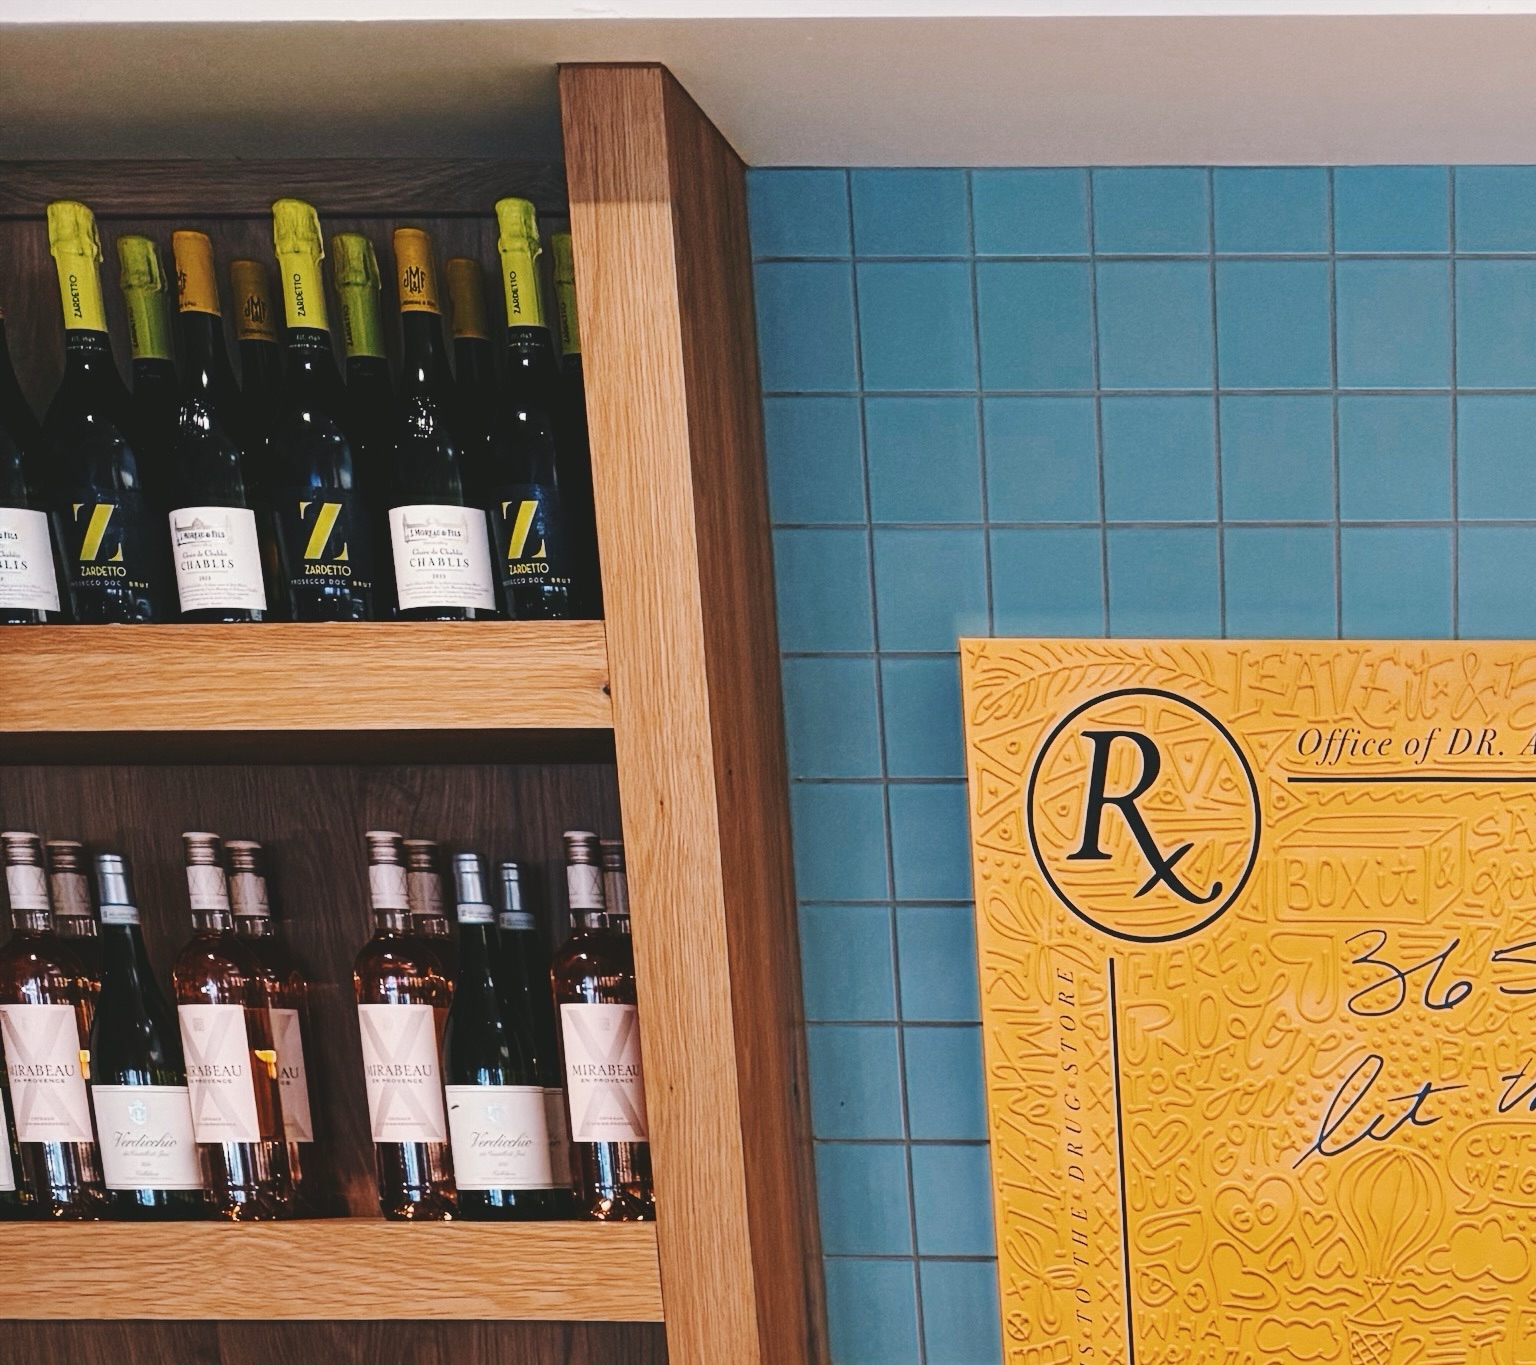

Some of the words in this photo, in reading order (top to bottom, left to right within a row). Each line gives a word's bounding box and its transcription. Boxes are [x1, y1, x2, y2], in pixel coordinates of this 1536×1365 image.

[69, 274, 83, 319] ZARDETTO
[293, 273, 306, 317] ZARDETTO
[511, 271, 522, 315] ZARDETTO
[80, 565, 127, 577] ZARDETTO
[181, 559, 234, 571] CHABLIS
[304, 564, 352, 577] ZARDETTO
[409, 557, 470, 569] CHABLIS
[508, 562, 550, 575] ZARDETTO
[1297, 727, 1392, 766] Office
[1403, 727, 1441, 765] of
[1446, 727, 1504, 758] DR.
[1056, 966, 1079, 1082] STORE
[572, 1064, 641, 1077] MIRABEAU
[1292, 1054, 1469, 1170] let
[1064, 1092, 1086, 1183] DRUG
[1071, 1206, 1092, 1268] THE
[1075, 1287, 1093, 1325] TO
